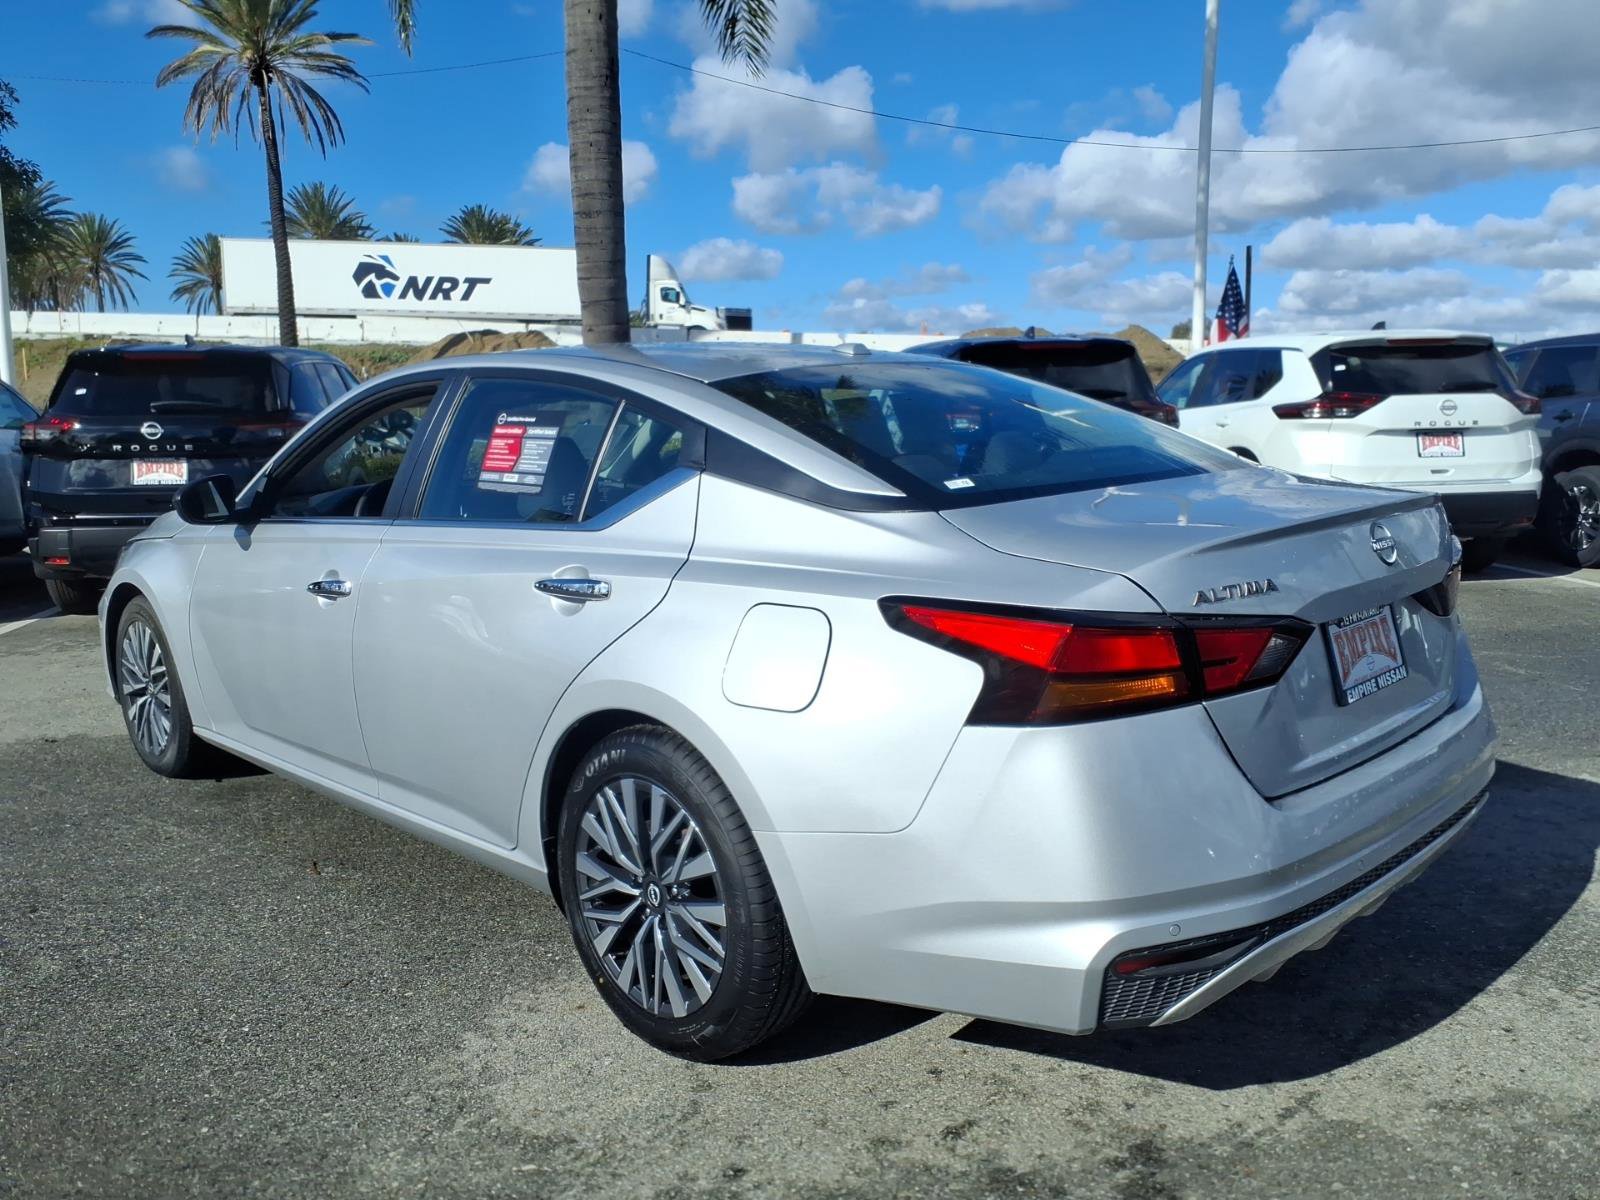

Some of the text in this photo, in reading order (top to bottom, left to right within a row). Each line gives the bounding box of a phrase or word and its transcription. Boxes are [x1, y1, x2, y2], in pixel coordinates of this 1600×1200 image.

[398, 275, 493, 302] NRT
[112, 444, 194, 452] ROGUE
[1421, 433, 1461, 452] EMPIRE
[135, 461, 185, 479] EMPIRE
[1191, 578, 1280, 607] ALTIMA
[1332, 613, 1400, 682] EMPIRE
[1346, 678, 1378, 704] EMPIRE
[1376, 664, 1408, 690] NISSAN
[585, 749, 627, 777] OTANI
